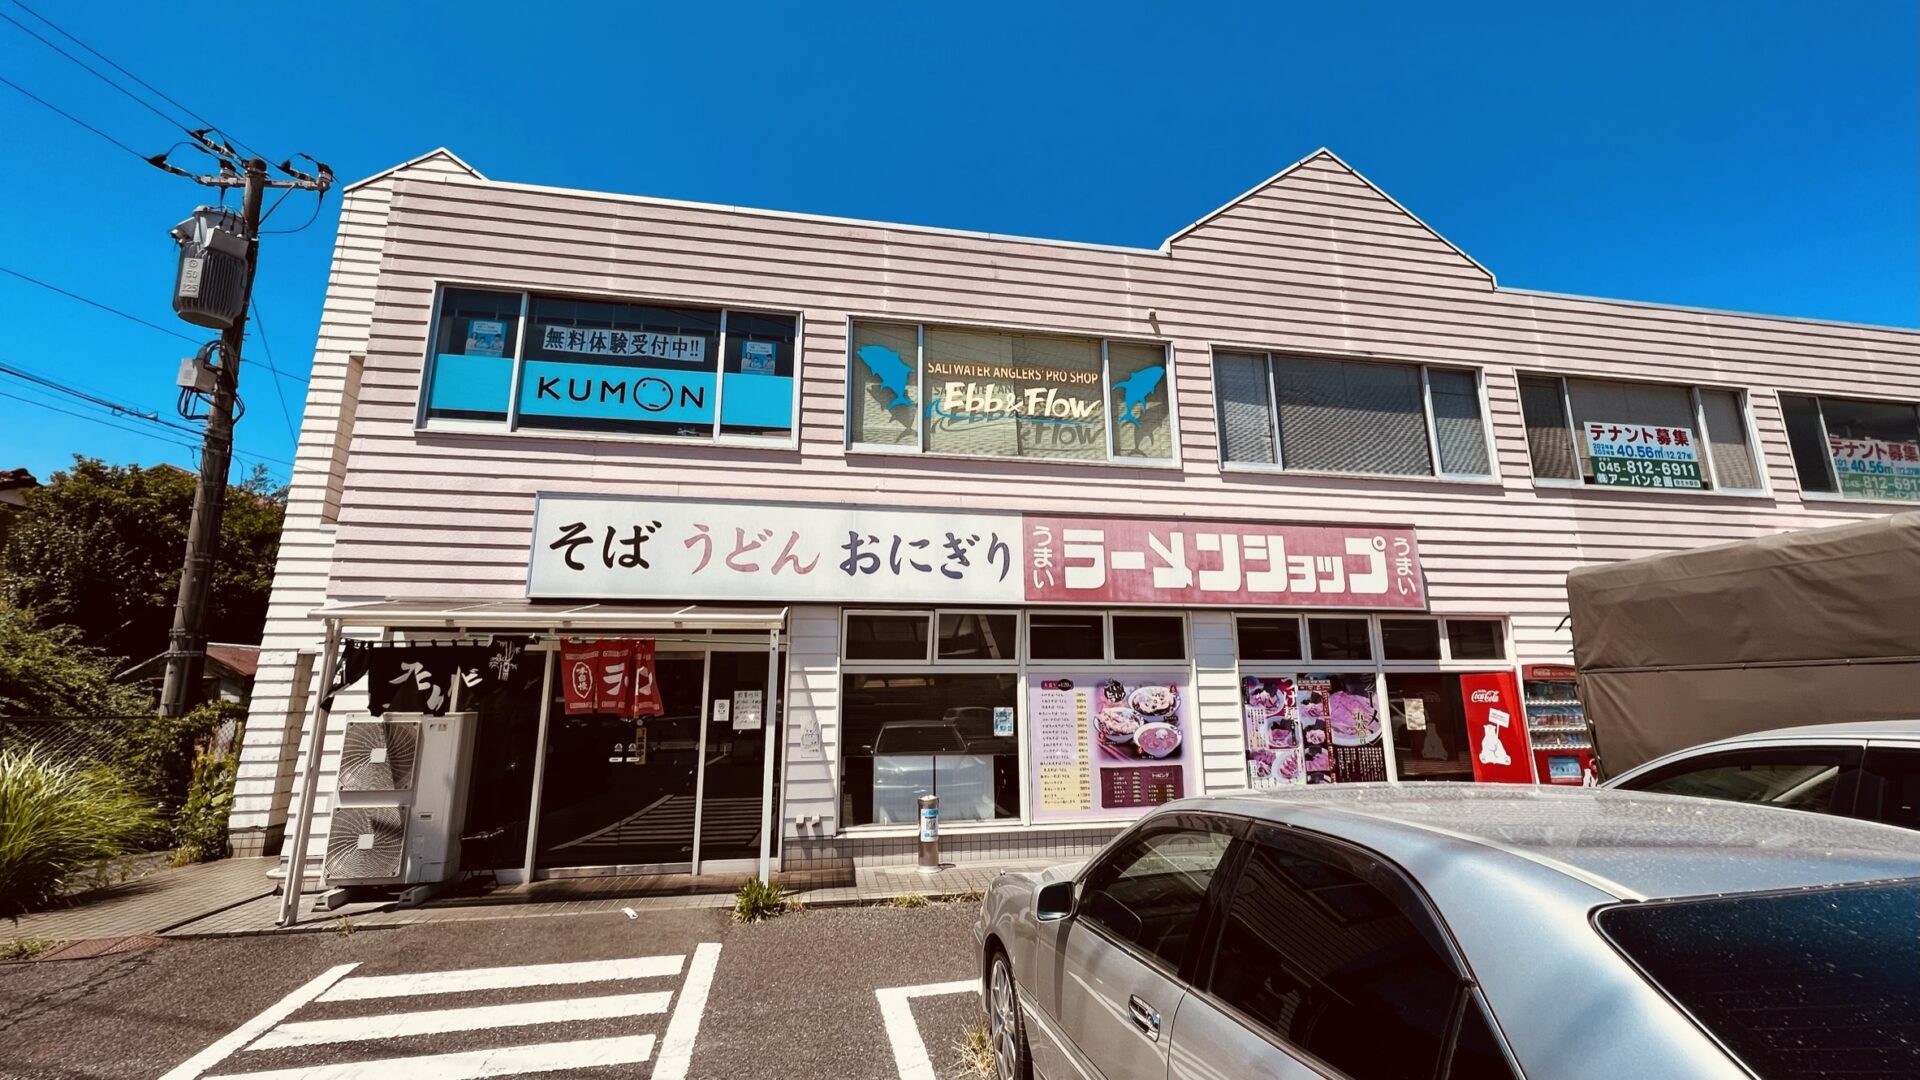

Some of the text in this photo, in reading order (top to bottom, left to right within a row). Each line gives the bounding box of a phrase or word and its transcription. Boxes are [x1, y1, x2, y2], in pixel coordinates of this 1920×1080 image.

[545, 327, 699, 358] 無料体験受付中!!
[928, 362, 990, 377] SALTWATER
[1046, 371, 1067, 382] PRO
[1070, 372, 1098, 384] SHOP
[538, 377, 704, 412] KUMON
[944, 382, 1002, 412] Ebb
[1024, 388, 1101, 417] Flow
[1590, 425, 1689, 446] テナント募集
[1830, 440, 1918, 462] テナント募集
[1599, 460, 1695, 477] 045-812-6911
[549, 520, 1011, 582] そば うどん おにぎり
[1032, 525, 1055, 589] うまい
[1063, 528, 1388, 594] ラーメンショップ
[1393, 537, 1416, 596] うまい
